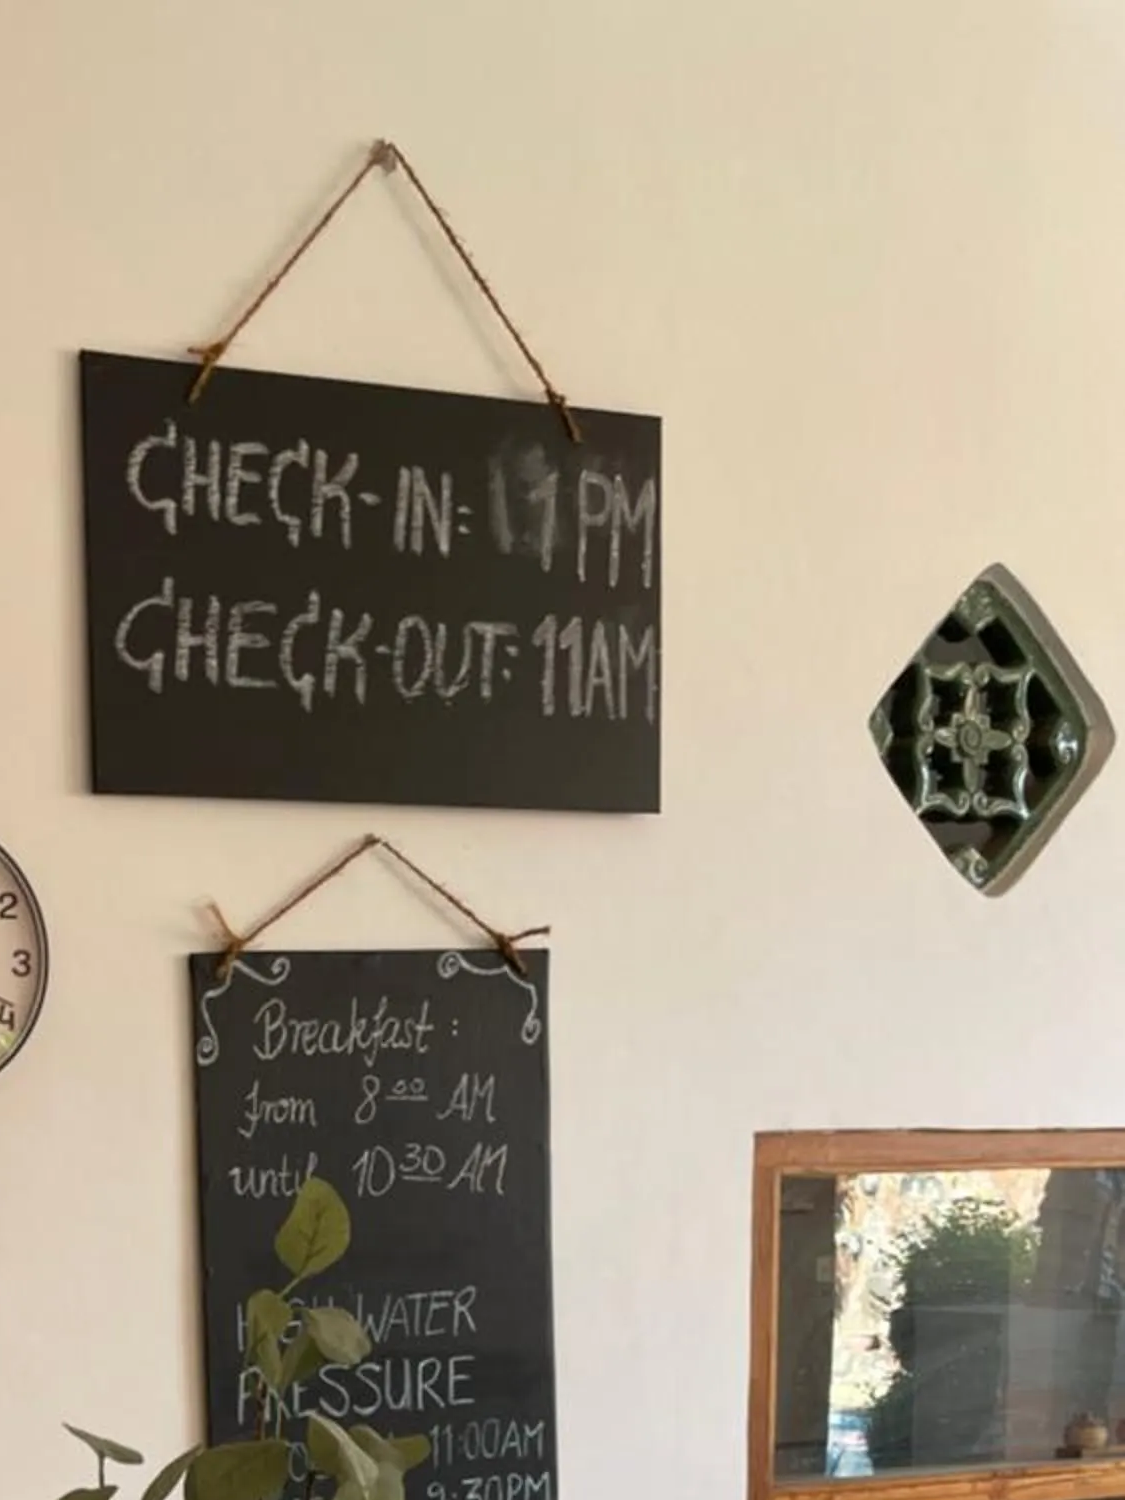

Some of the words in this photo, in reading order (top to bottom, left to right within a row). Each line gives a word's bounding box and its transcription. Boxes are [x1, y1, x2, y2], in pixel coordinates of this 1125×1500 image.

[578, 469, 657, 589] PM
[12, 950, 31, 977] 3
[237, 1080, 317, 1138] from
[436, 1072, 497, 1123] AM
[228, 1151, 319, 1199] until
[447, 1143, 509, 1195] AM
[357, 1285, 478, 1343] WATER
